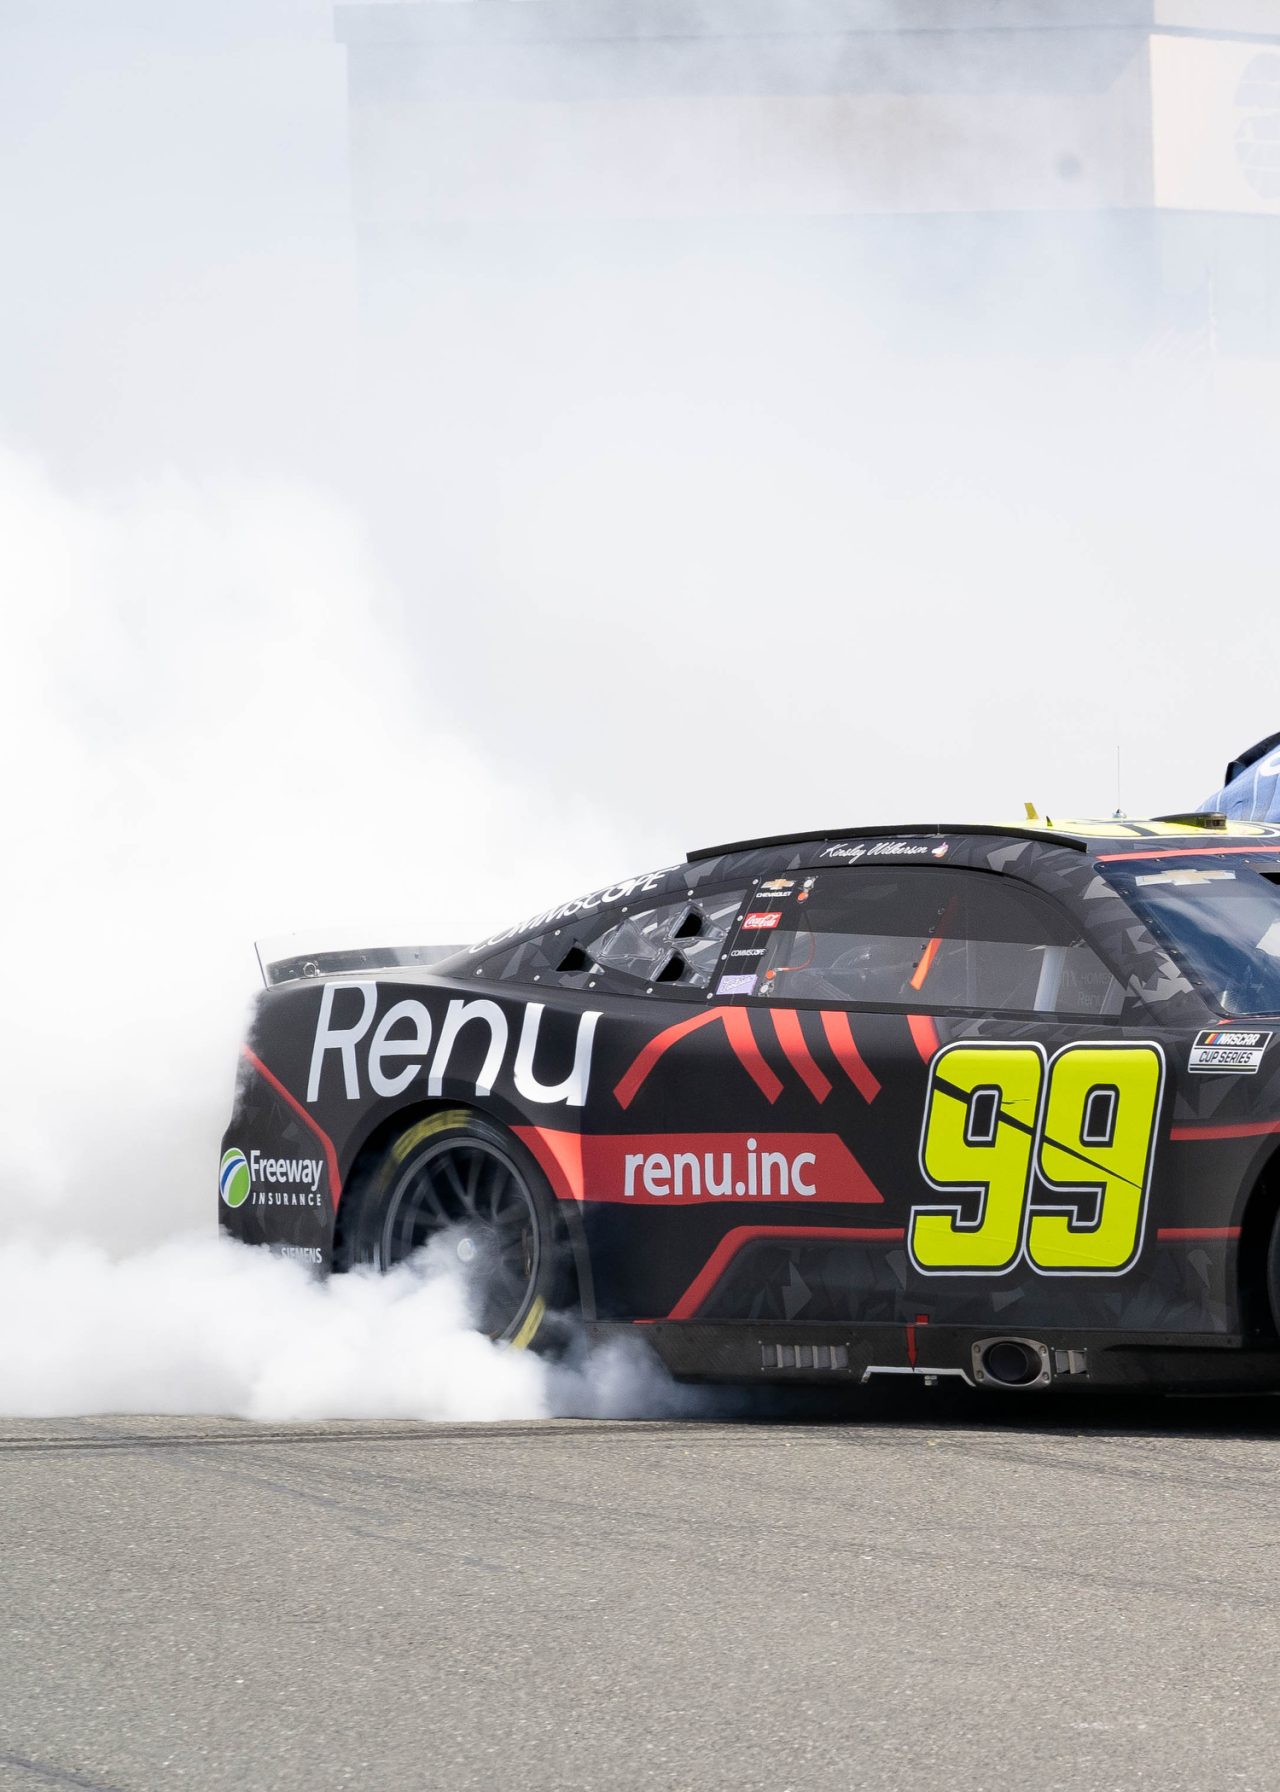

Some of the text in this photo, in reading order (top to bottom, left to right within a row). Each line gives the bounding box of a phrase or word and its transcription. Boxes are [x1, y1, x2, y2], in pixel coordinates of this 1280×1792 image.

[867, 842, 928, 856] Wilkerson
[306, 980, 604, 1107] Renu
[1217, 1033, 1259, 1046] NASCAR
[1198, 1050, 1254, 1065] CUP SERIES
[623, 1137, 817, 1197] renu.inc
[907, 1040, 1167, 1278] 99
[250, 1149, 324, 1192] Freeway
[252, 1192, 322, 1206] INSURANCE
[281, 1247, 323, 1264] SIEMENS
